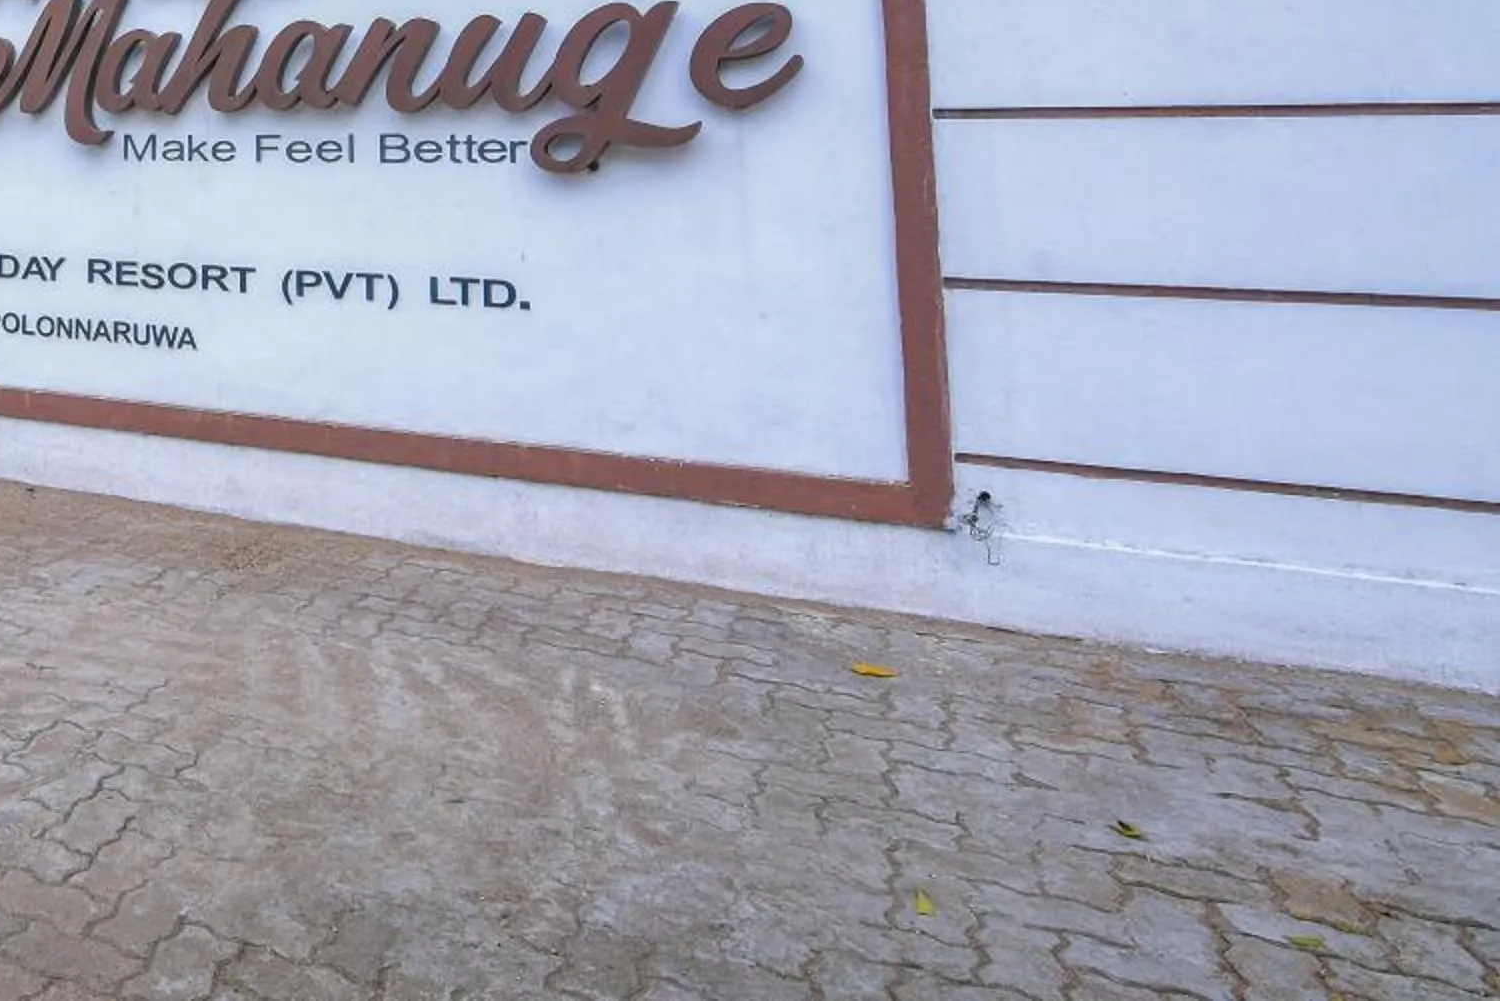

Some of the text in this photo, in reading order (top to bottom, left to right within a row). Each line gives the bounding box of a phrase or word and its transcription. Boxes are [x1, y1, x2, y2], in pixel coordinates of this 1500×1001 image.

[123, 133, 529, 165] Make Feel Better
[87, 258, 257, 294] RESORT
[281, 268, 400, 311] (PVT)
[429, 275, 532, 311] LTD.
